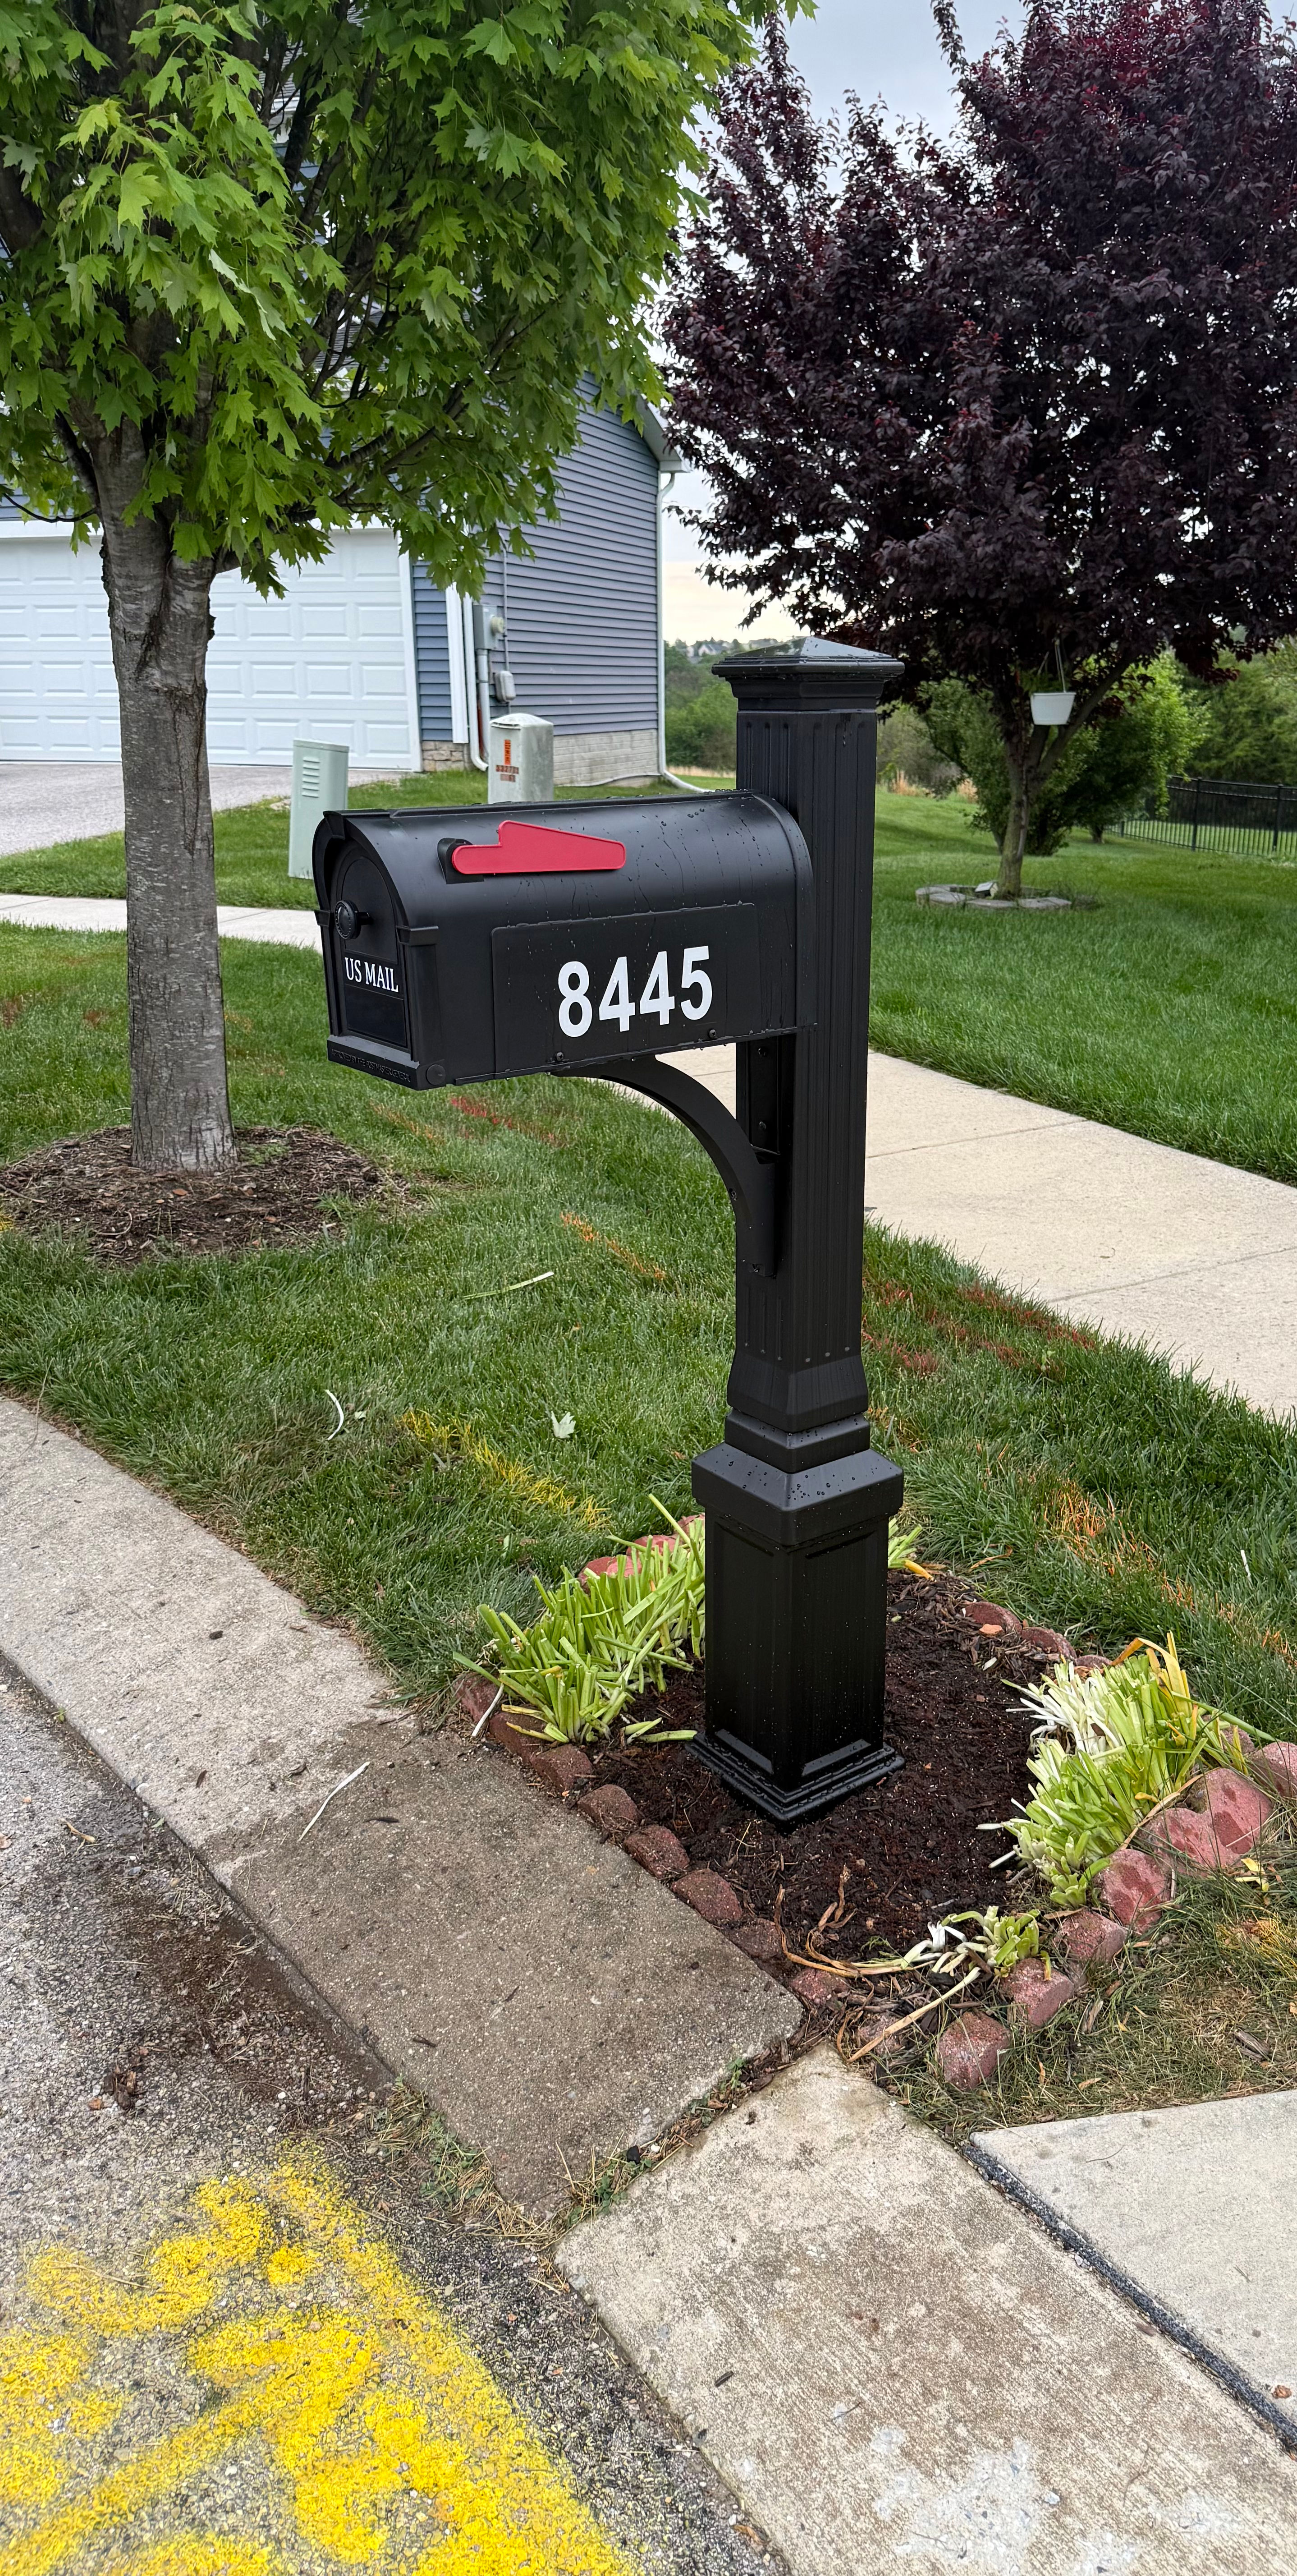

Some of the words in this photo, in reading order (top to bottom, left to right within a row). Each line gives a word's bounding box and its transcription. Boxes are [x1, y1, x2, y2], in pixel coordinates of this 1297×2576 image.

[345, 957, 362, 982] US
[364, 962, 399, 992] MAIL
[558, 945, 712, 1037] 8445
